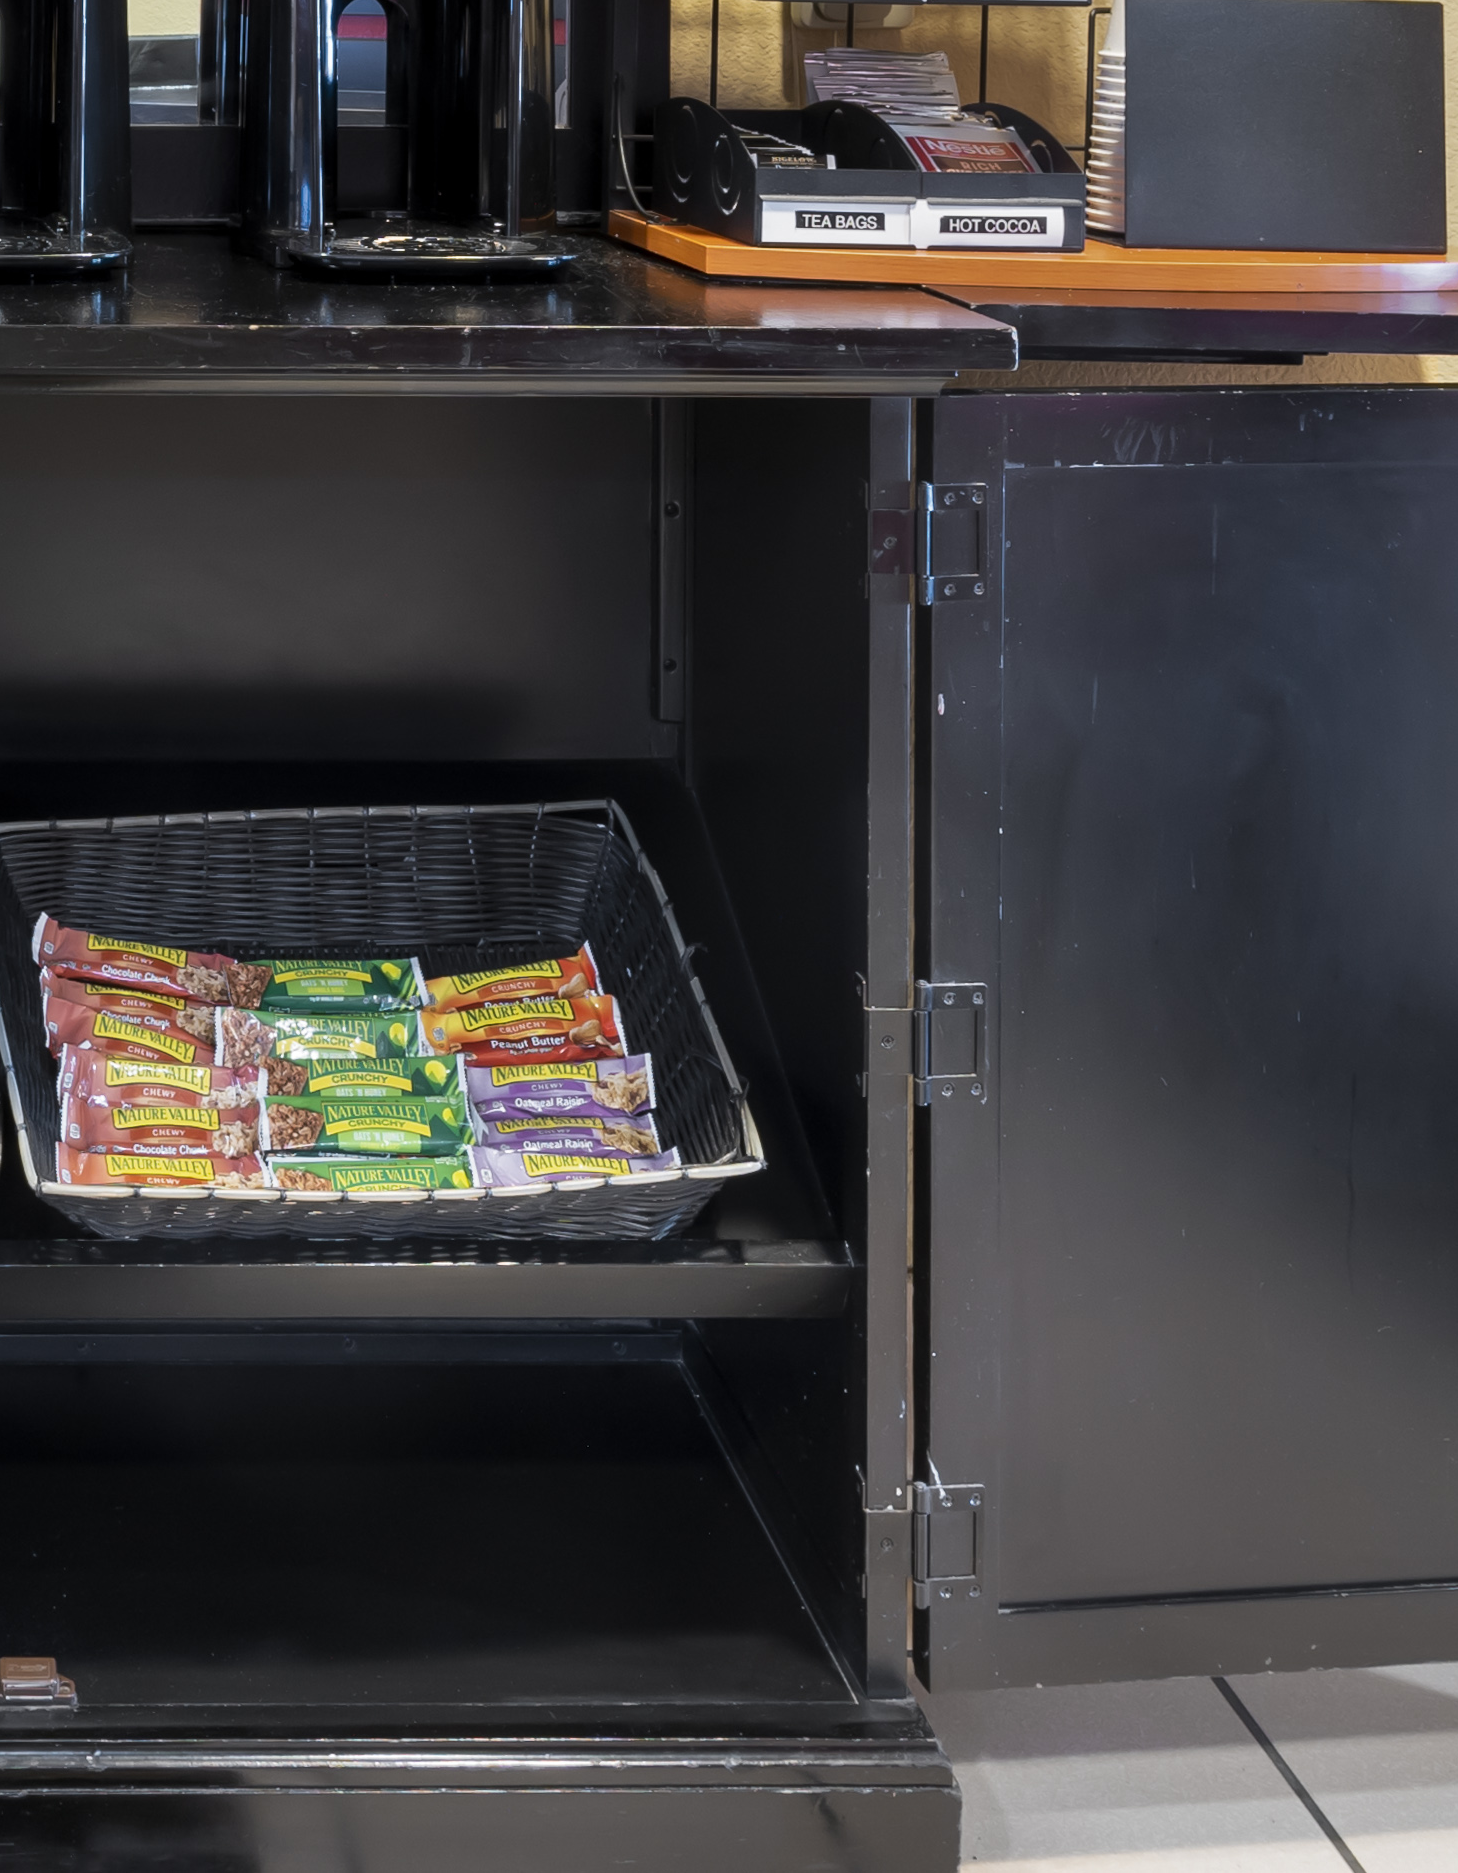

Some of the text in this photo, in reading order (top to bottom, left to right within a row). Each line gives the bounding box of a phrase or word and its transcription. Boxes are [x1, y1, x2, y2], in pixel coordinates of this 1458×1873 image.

[960, 160, 1002, 171] RICH
[802, 214, 877, 229] TEA BAGS
[949, 218, 1041, 233] HOT COCOA
[92, 934, 184, 964] NATURE VALLEY
[122, 954, 154, 965] CHEWY
[101, 964, 142, 980] Chocolate
[295, 969, 348, 977] CRUNCHY
[491, 981, 536, 994] CRUNCHY
[121, 998, 153, 1009] CHEWY
[467, 1000, 570, 1027] NATURE VALLEY
[144, 1015, 171, 1028] Chunk
[499, 1021, 546, 1034] CRUNCHY
[327, 1020, 370, 1039] VALLEY
[98, 1016, 194, 1060] NATURE VALLEY
[491, 1035, 566, 1050] Peanut Butter
[127, 1045, 160, 1060] CHEWY
[311, 1058, 404, 1077] NATURE VALLEY
[496, 1063, 593, 1083] NATURE VALLEY
[110, 1061, 207, 1090] NATURE VALLEY
[331, 1074, 388, 1084] CRUNCHY
[143, 1087, 176, 1098] CHEWY
[531, 1083, 564, 1091] CHEWY
[514, 1096, 585, 1109] Oatmeal Raisin
[118, 1108, 214, 1128] NATURE VALLEY
[326, 1105, 421, 1124] NATURE VALLEY
[348, 1118, 406, 1128] CRUNCHY
[152, 1128, 186, 1137] CHEWY
[133, 1144, 177, 1155] Chocolate
[523, 1139, 593, 1151] Oatmeal Raisin
[110, 1156, 210, 1178] NATURE VALLEY
[529, 1154, 627, 1174] NATURE VALLEY
[146, 1177, 181, 1186] CHEWY
[335, 1169, 435, 1189] NATURE VALLEY
